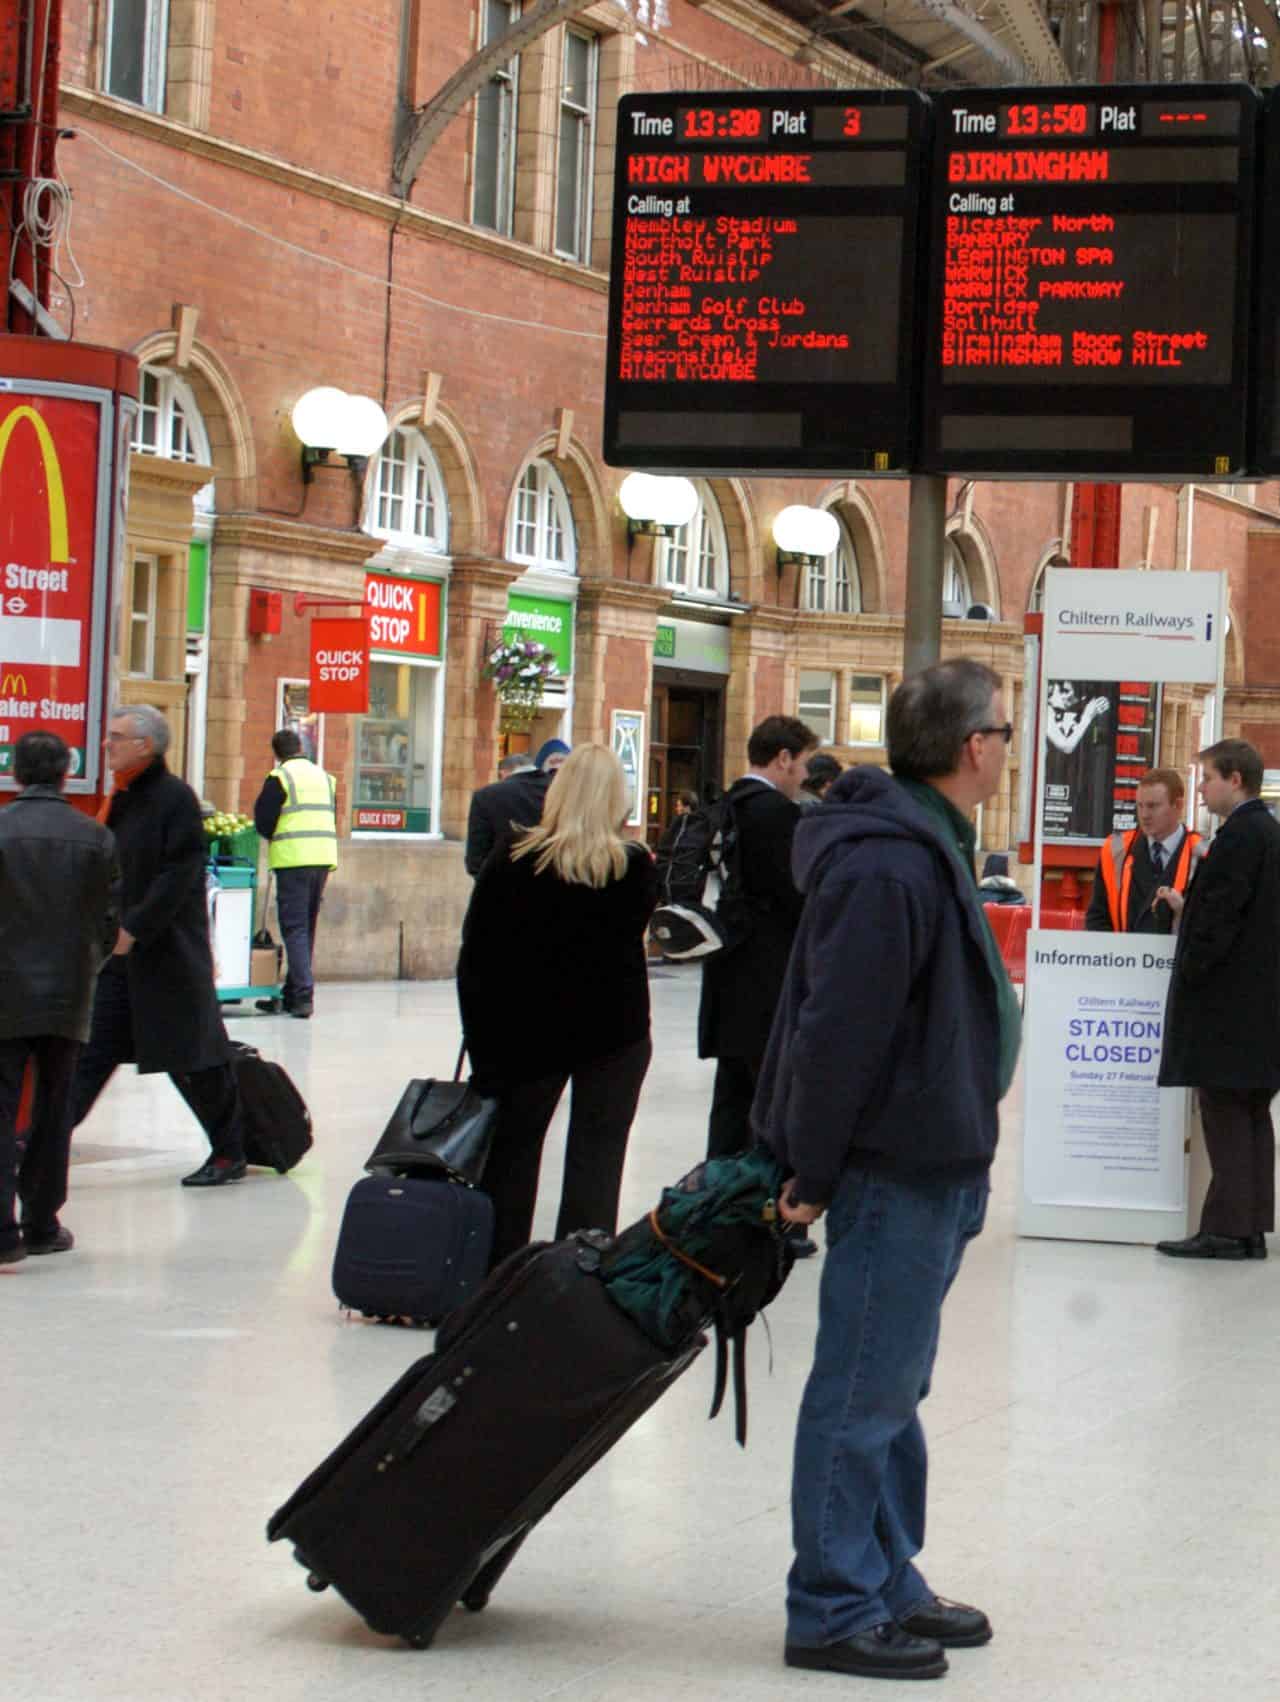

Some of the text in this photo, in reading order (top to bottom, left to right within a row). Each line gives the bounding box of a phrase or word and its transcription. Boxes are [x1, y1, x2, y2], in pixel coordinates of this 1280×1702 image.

[631, 111, 672, 135] Time
[772, 110, 806, 134] Plat
[843, 107, 861, 136] 3
[952, 105, 1136, 134] Time 13:50 Plat
[627, 155, 812, 183] HIGH WYCOMBE
[949, 151, 1109, 182] BIRMINGHAM
[627, 195, 690, 217] Calling at
[949, 193, 1014, 215] Calling at
[627, 217, 797, 234] Wembley Stadium
[947, 215, 1114, 232] Bicester North
[625, 233, 772, 249] Northolt Park
[625, 250, 773, 266] South Ruislip
[946, 248, 1113, 265] LEAMINGTON SPA
[624, 266, 760, 282] West Ruislip
[1039, 281, 1124, 298] PARKWAY
[701, 298, 750, 315] Golf
[758, 298, 805, 315] Club
[723, 315, 780, 331] Cross
[677, 331, 734, 348] Green
[768, 331, 848, 348] Jordans
[1072, 331, 1121, 348] Moor
[1132, 331, 1207, 348] Street
[621, 349, 756, 365] Beaconsfield
[1072, 348, 1121, 366] SNOW
[1132, 348, 1182, 366] HILL
[620, 364, 666, 380] HIGH
[5, 563, 68, 592] Street
[368, 581, 413, 612] QUICK
[1058, 609, 1193, 630] Chiltern Railways
[370, 615, 410, 644] STOP
[316, 650, 363, 665] QUICK
[320, 667, 359, 681] STOP
[0, 697, 84, 721] aker Street
[1034, 949, 1177, 970] Information Des
[1068, 1018, 1161, 1039] STATION
